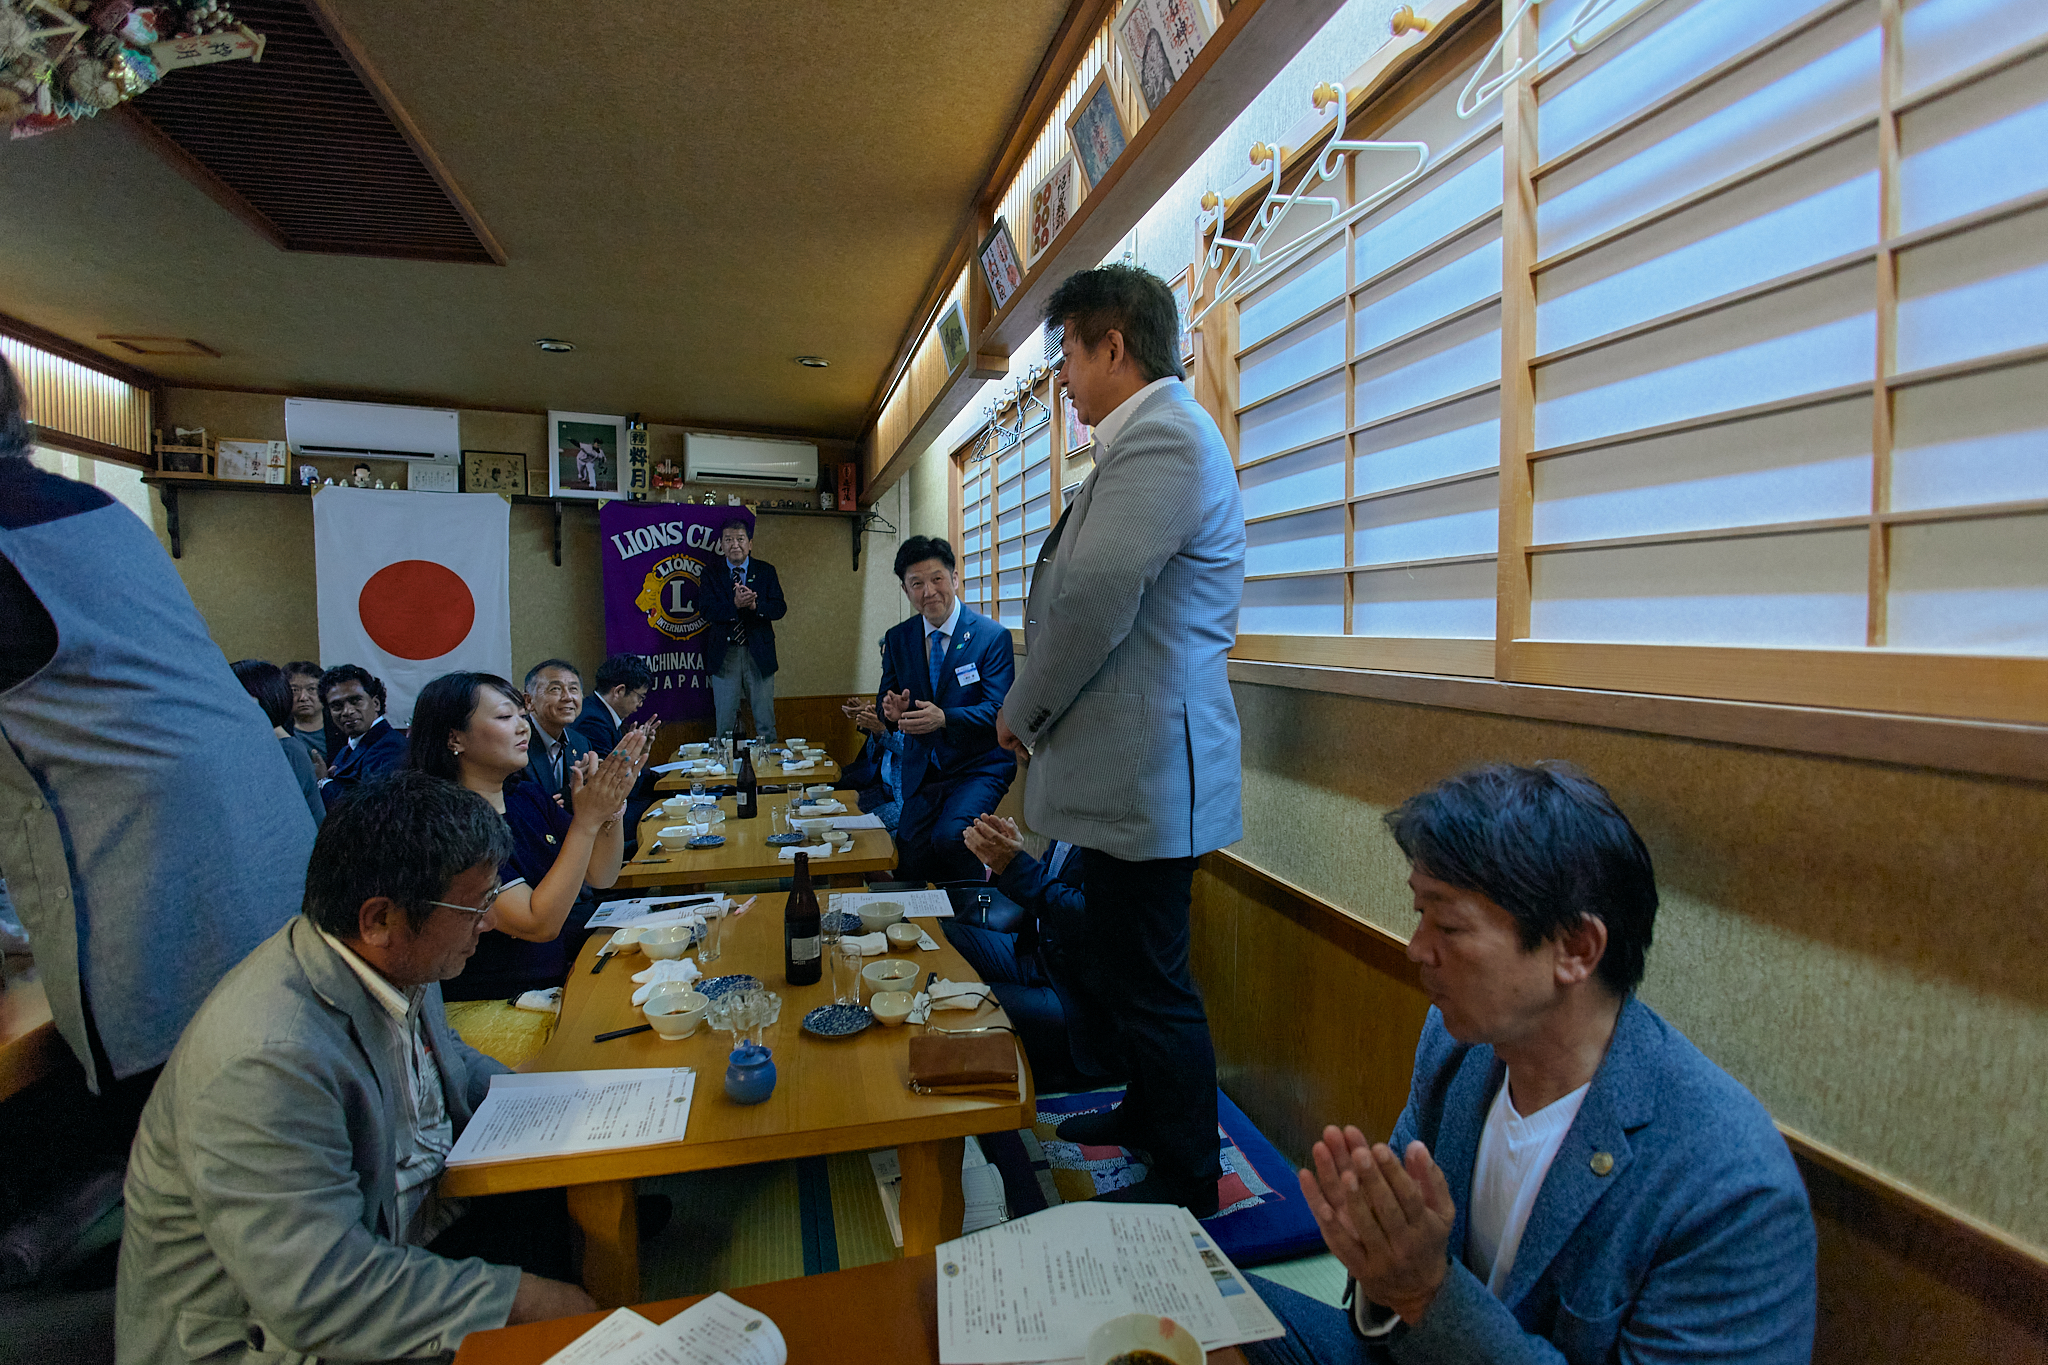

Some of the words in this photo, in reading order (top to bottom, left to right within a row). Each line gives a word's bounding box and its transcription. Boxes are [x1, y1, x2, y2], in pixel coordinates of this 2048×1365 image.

[611, 521, 683, 560] LIONS
[656, 558, 703, 577] LIONS
[669, 580, 695, 613] L
[656, 616, 707, 633] INTERNATIONAL
